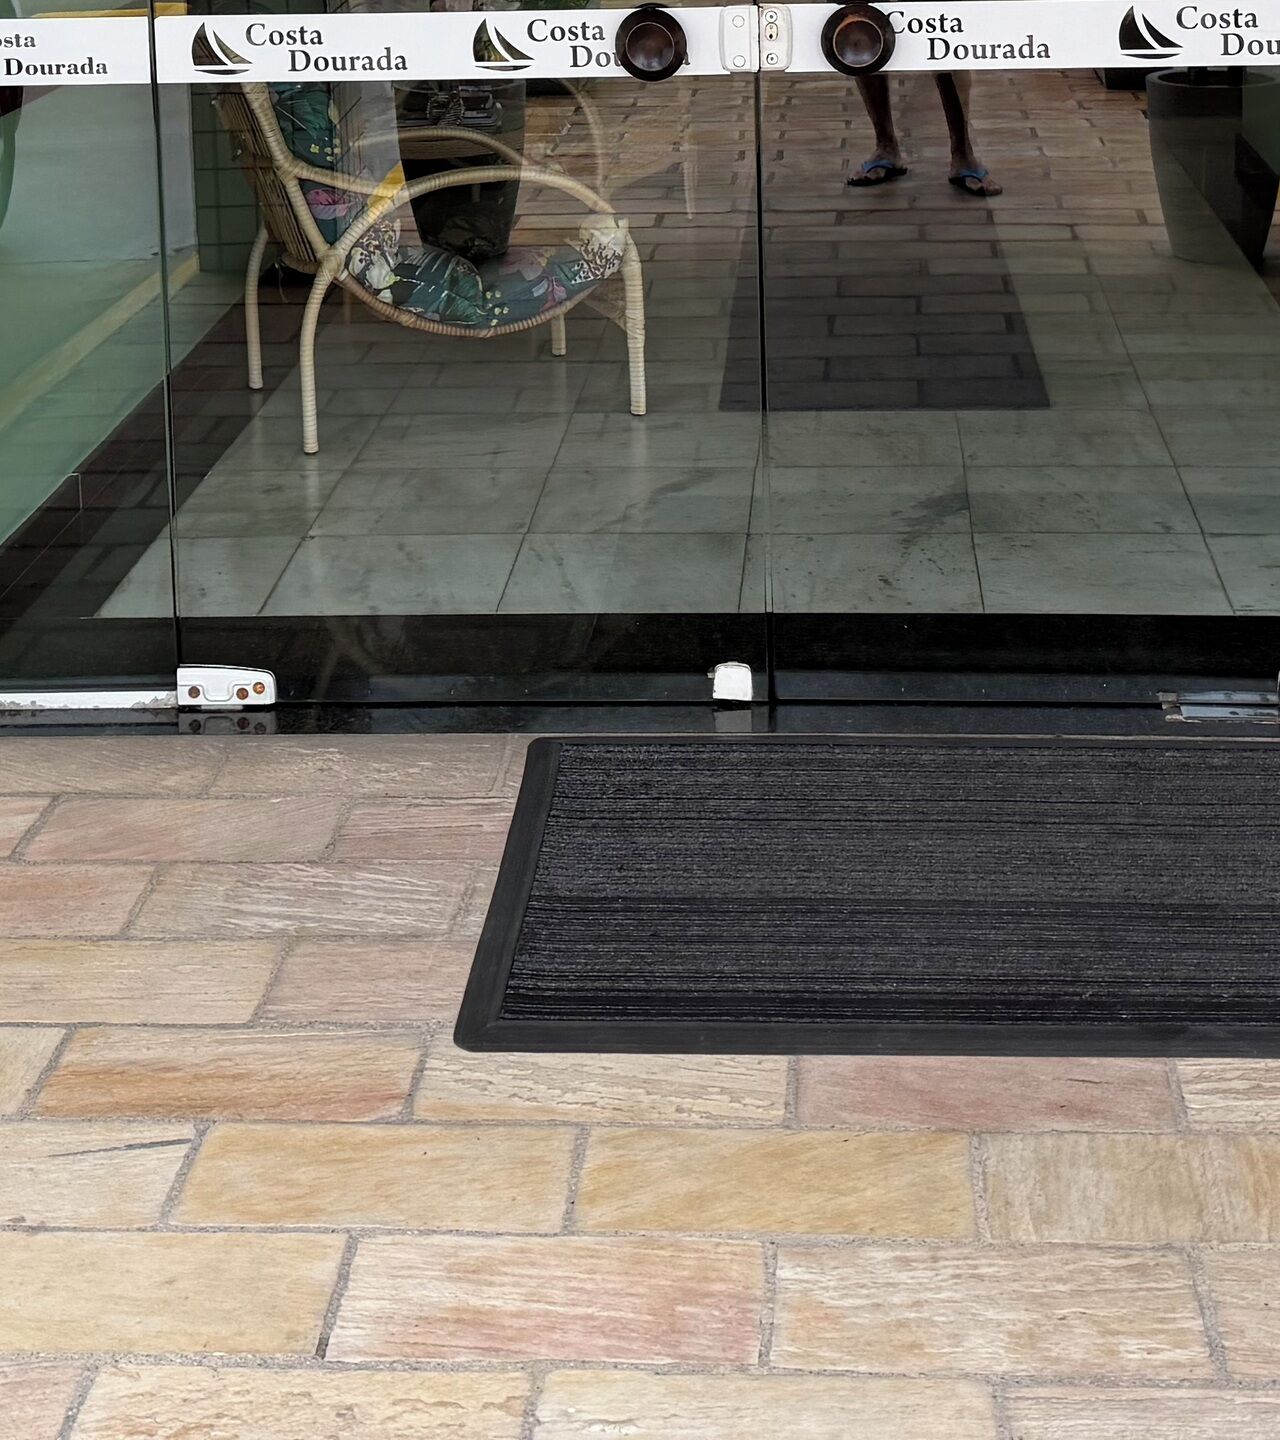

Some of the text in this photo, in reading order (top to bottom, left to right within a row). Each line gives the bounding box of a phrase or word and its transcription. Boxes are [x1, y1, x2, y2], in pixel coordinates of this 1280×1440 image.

[886, 10, 964, 34] Costa
[1176, 5, 1259, 29] Costa
[245, 23, 324, 46] Costa
[527, 18, 606, 42] Costa
[926, 34, 1051, 60] Dourada
[3, 56, 108, 76] Dourada
[287, 47, 408, 72] Dourada
